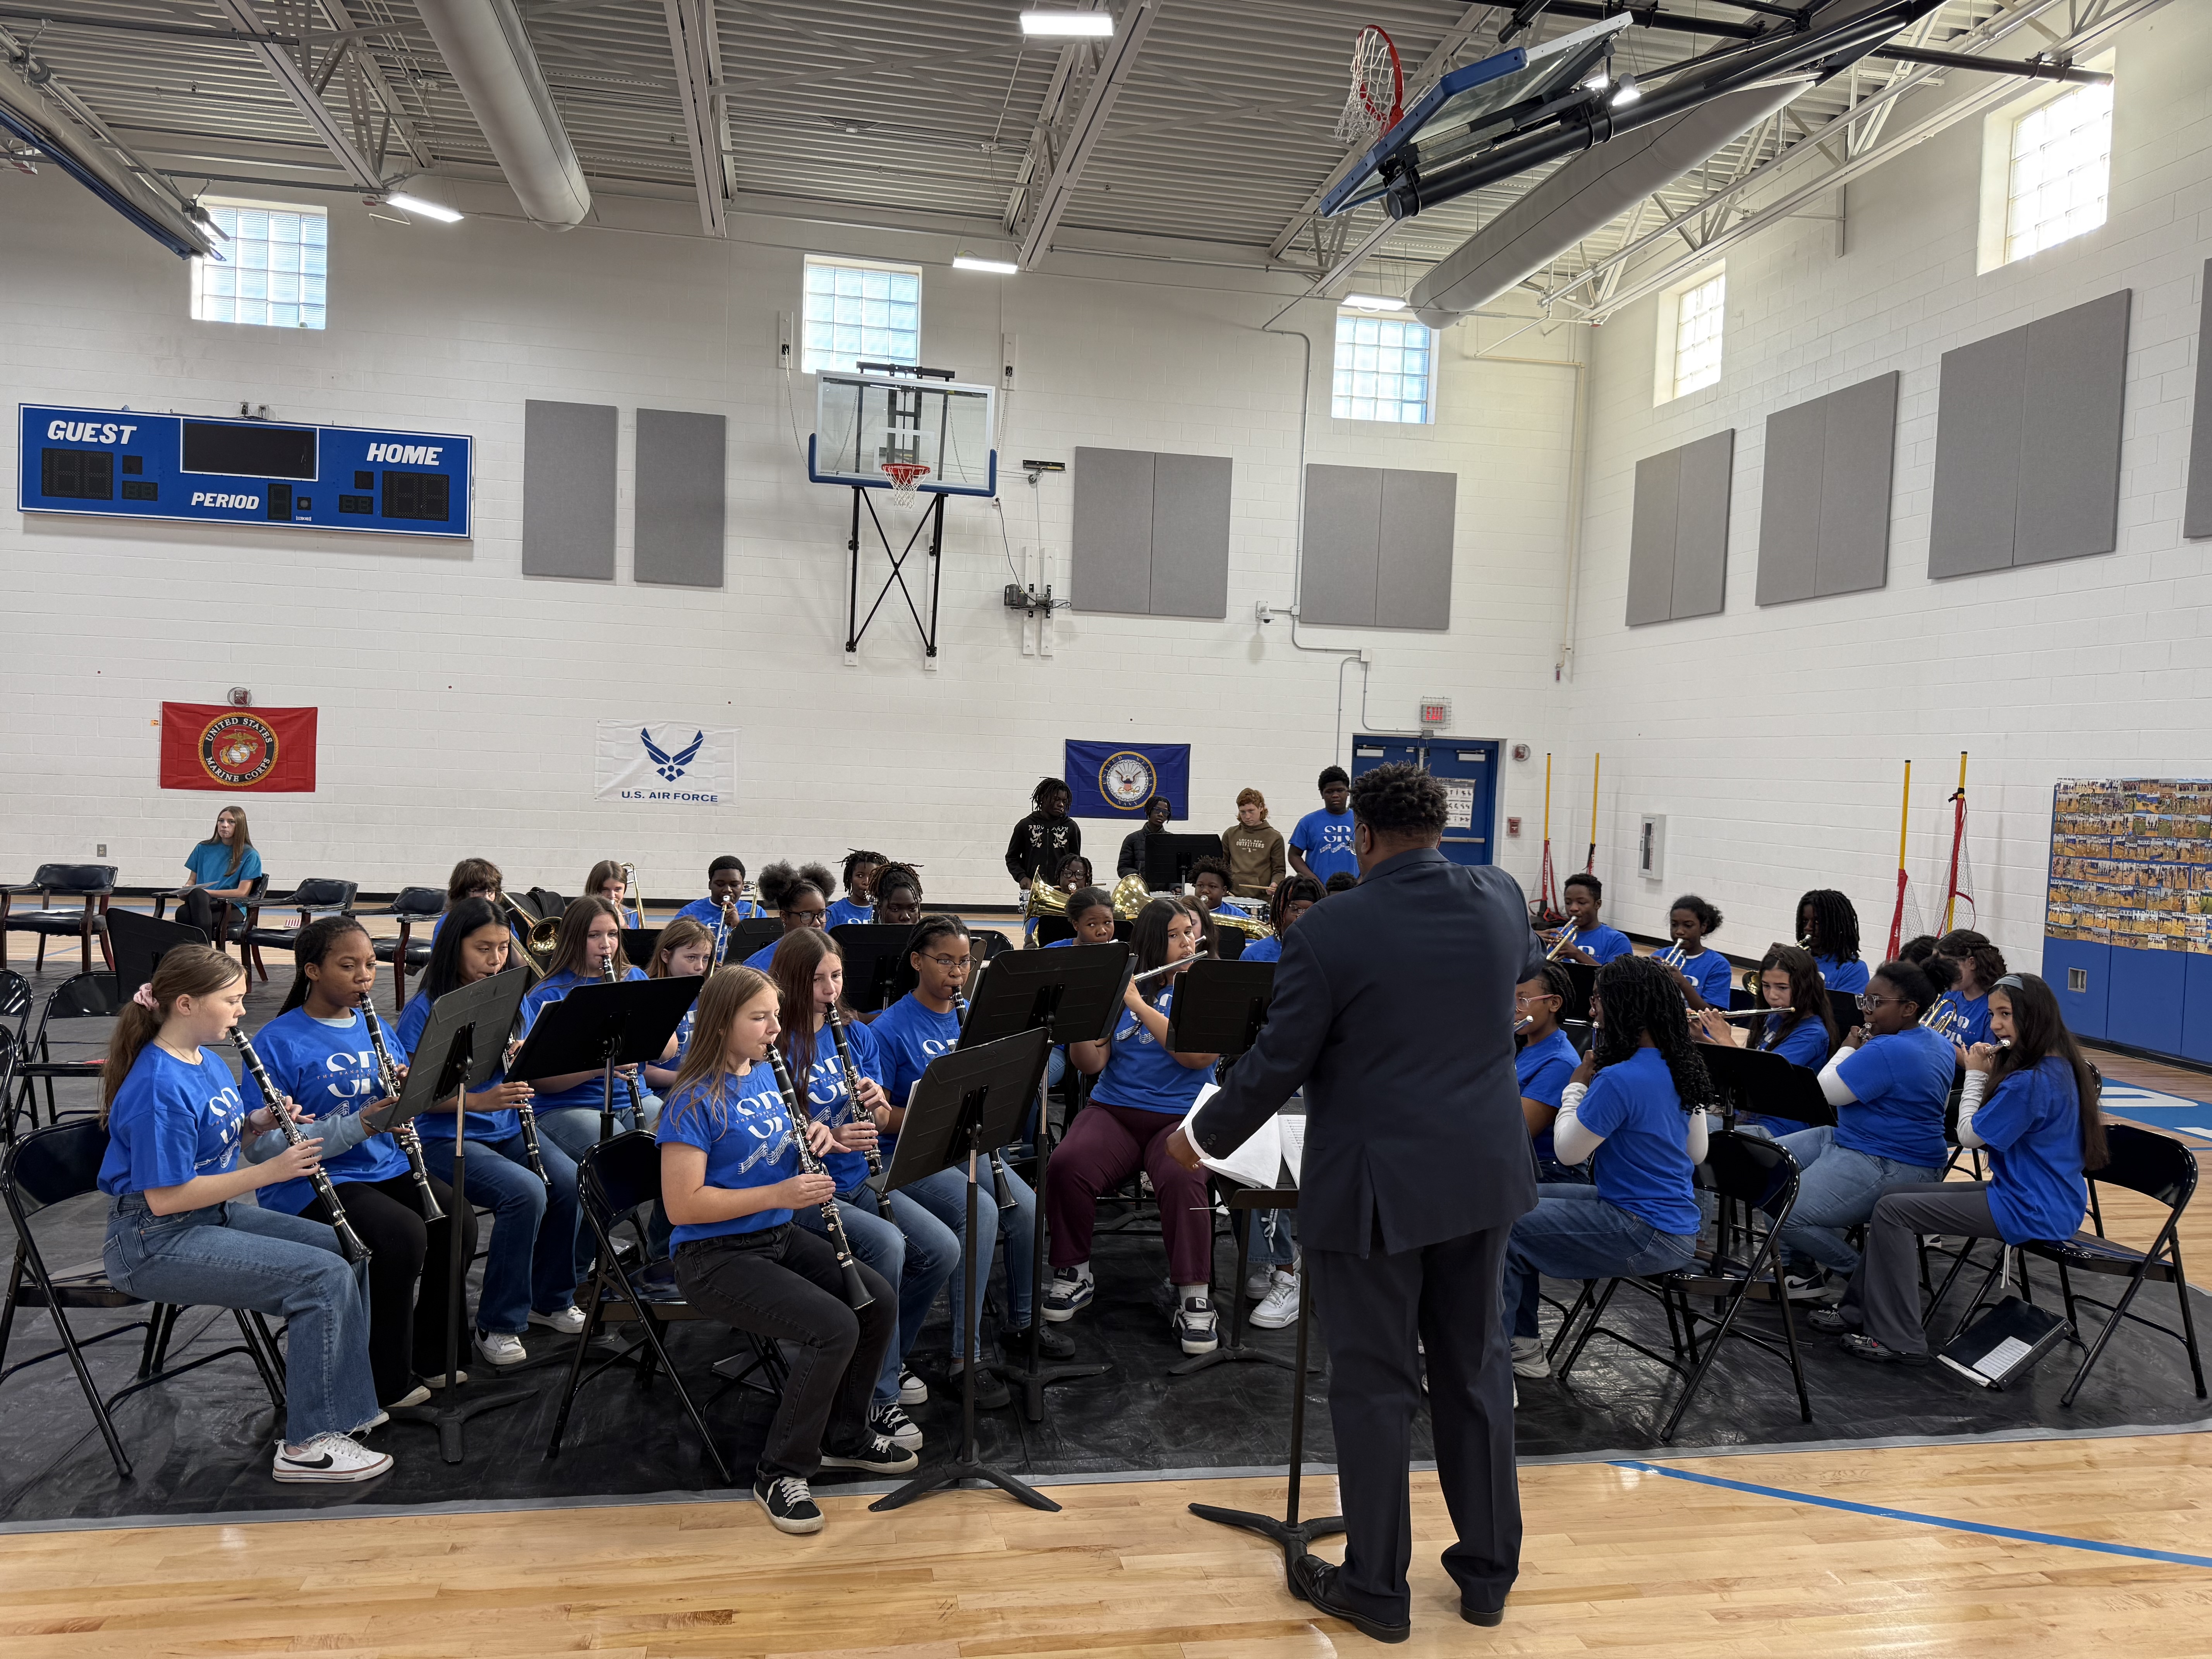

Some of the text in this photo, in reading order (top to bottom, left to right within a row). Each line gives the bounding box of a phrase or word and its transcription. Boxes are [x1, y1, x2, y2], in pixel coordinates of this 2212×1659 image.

[47, 420, 137, 445] GUEST
[366, 443, 443, 465] HOME
[191, 492, 259, 510] PERIOD
[1426, 706, 1443, 720] EXIT
[205, 717, 273, 743] UNITED STATES
[206, 756, 270, 782] MARINE CORPS
[1103, 756, 1153, 787] UNITED STATES
[673, 793, 718, 802] FORCE
